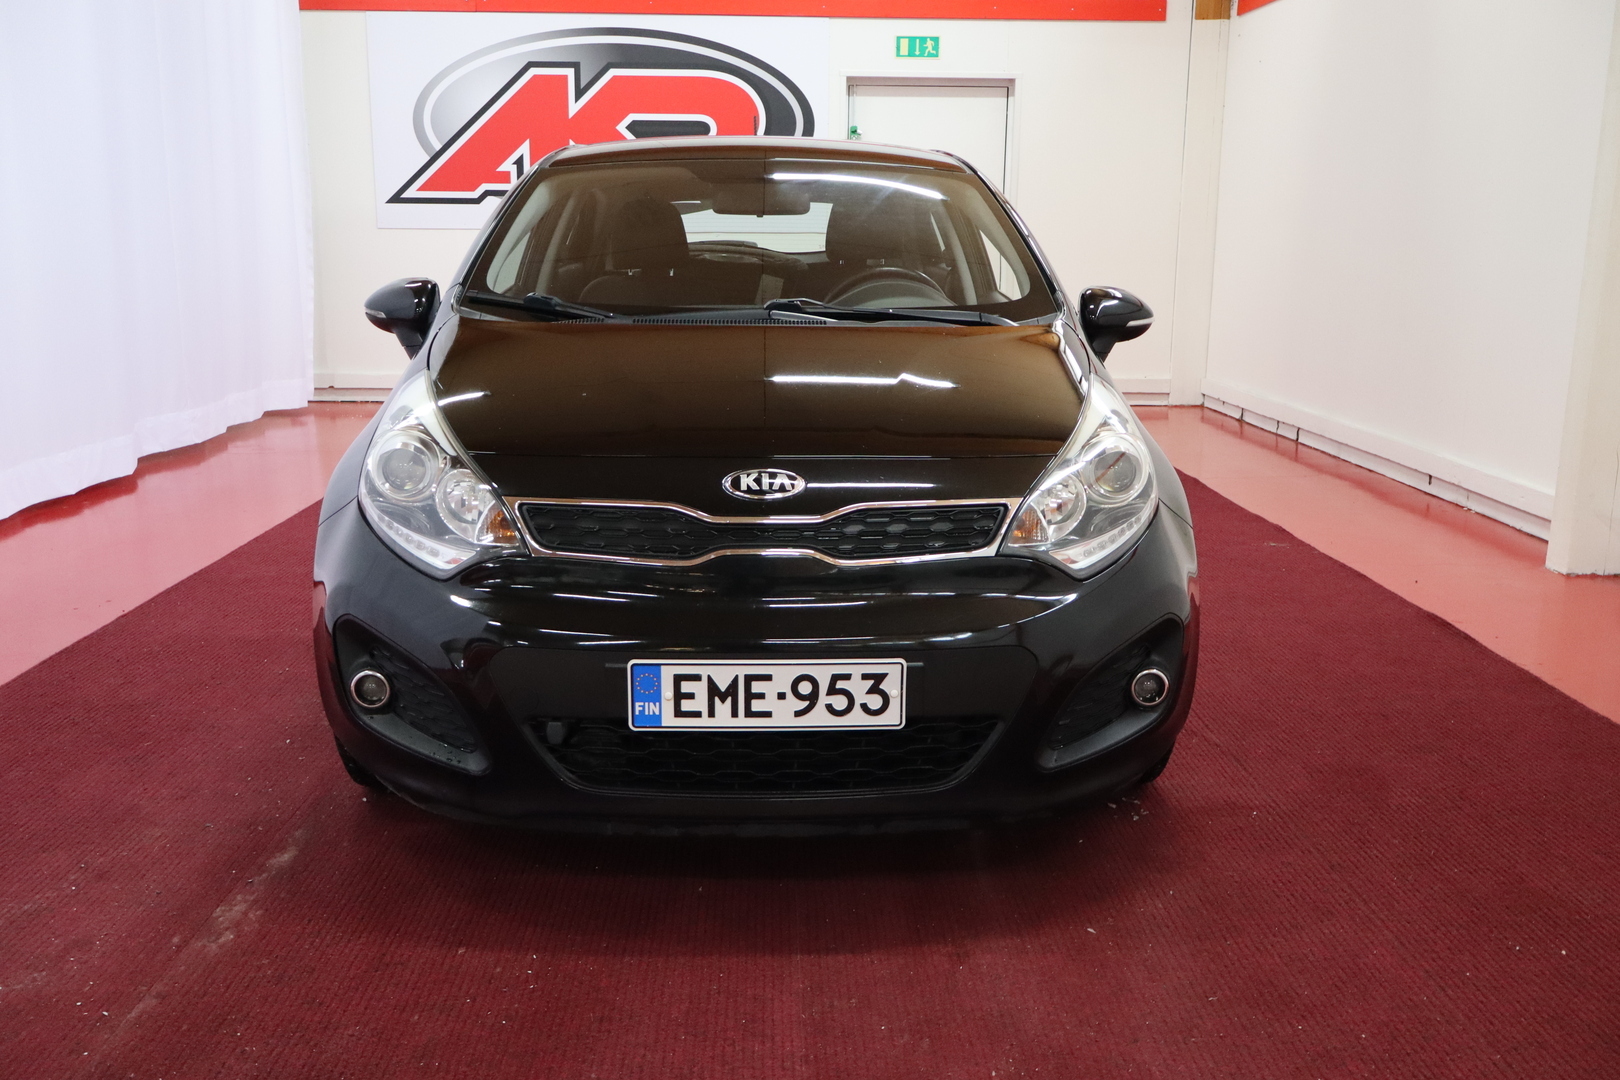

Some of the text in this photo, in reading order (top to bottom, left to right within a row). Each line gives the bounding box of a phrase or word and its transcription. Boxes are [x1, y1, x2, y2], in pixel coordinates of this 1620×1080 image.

[739, 472, 793, 491] KIA
[673, 672, 891, 718] EME-953
[635, 702, 660, 716] FIN
